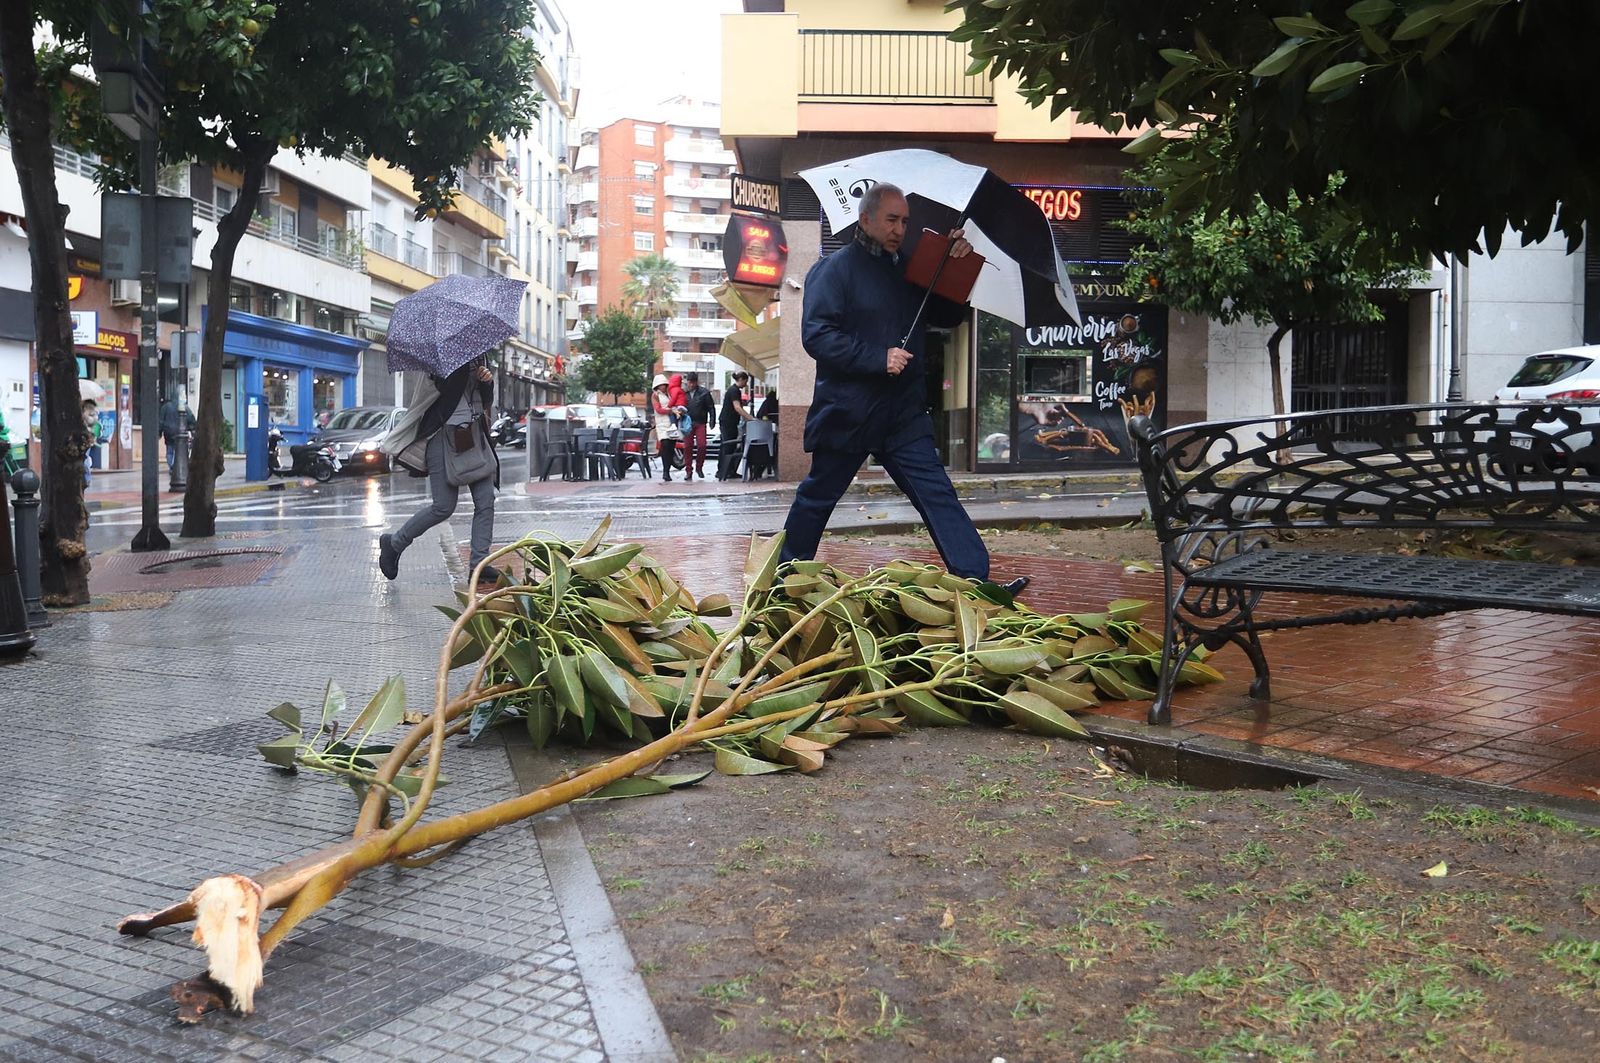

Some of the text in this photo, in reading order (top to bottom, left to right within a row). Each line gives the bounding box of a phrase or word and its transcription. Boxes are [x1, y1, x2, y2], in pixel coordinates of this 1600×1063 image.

[733, 177, 780, 213] CHURRERIA
[748, 226, 769, 238] SALA
[740, 262, 776, 276] DE JUEGOS
[1102, 339, 1152, 363] Las Vegas
[1095, 381, 1127, 401] Coffee
